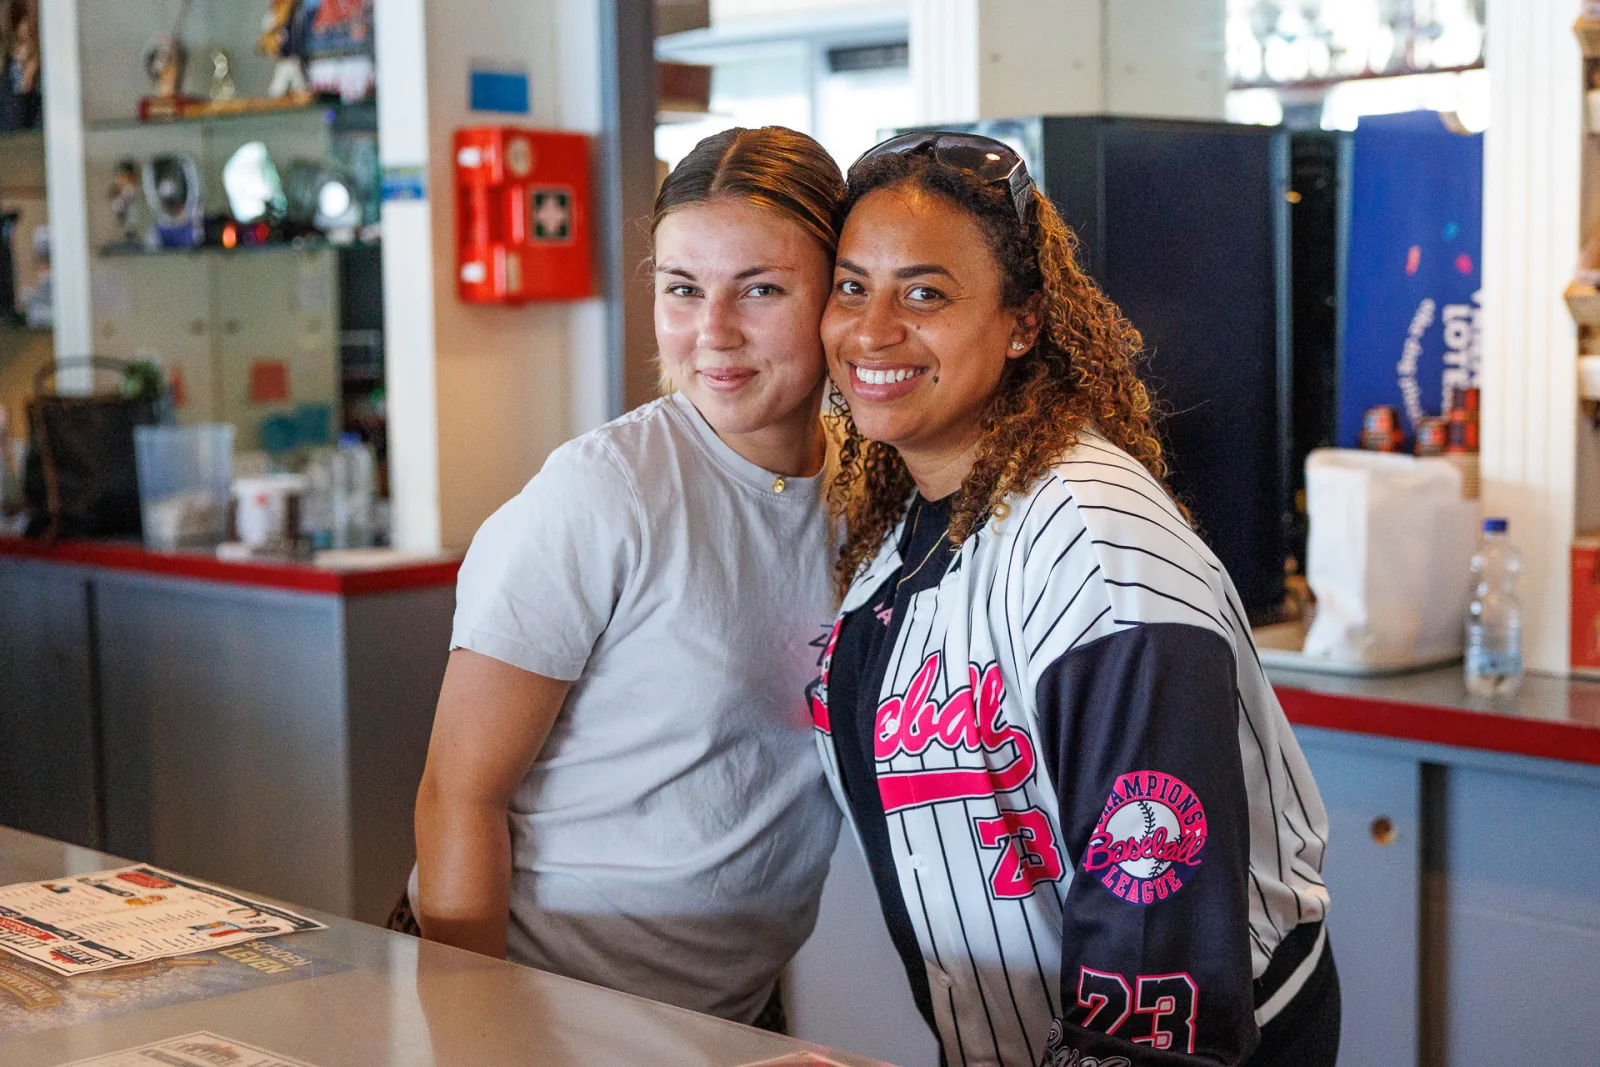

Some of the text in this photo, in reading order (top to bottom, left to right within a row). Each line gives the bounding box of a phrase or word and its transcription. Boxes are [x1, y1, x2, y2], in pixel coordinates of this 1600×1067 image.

[1097, 774, 1203, 826] AMPIONS
[974, 805, 1066, 900] 23
[1082, 827, 1206, 872] Baseball
[1101, 865, 1183, 904] LEAGUE
[218, 947, 291, 974] LEVEN
[1077, 965, 1198, 1054] 23
